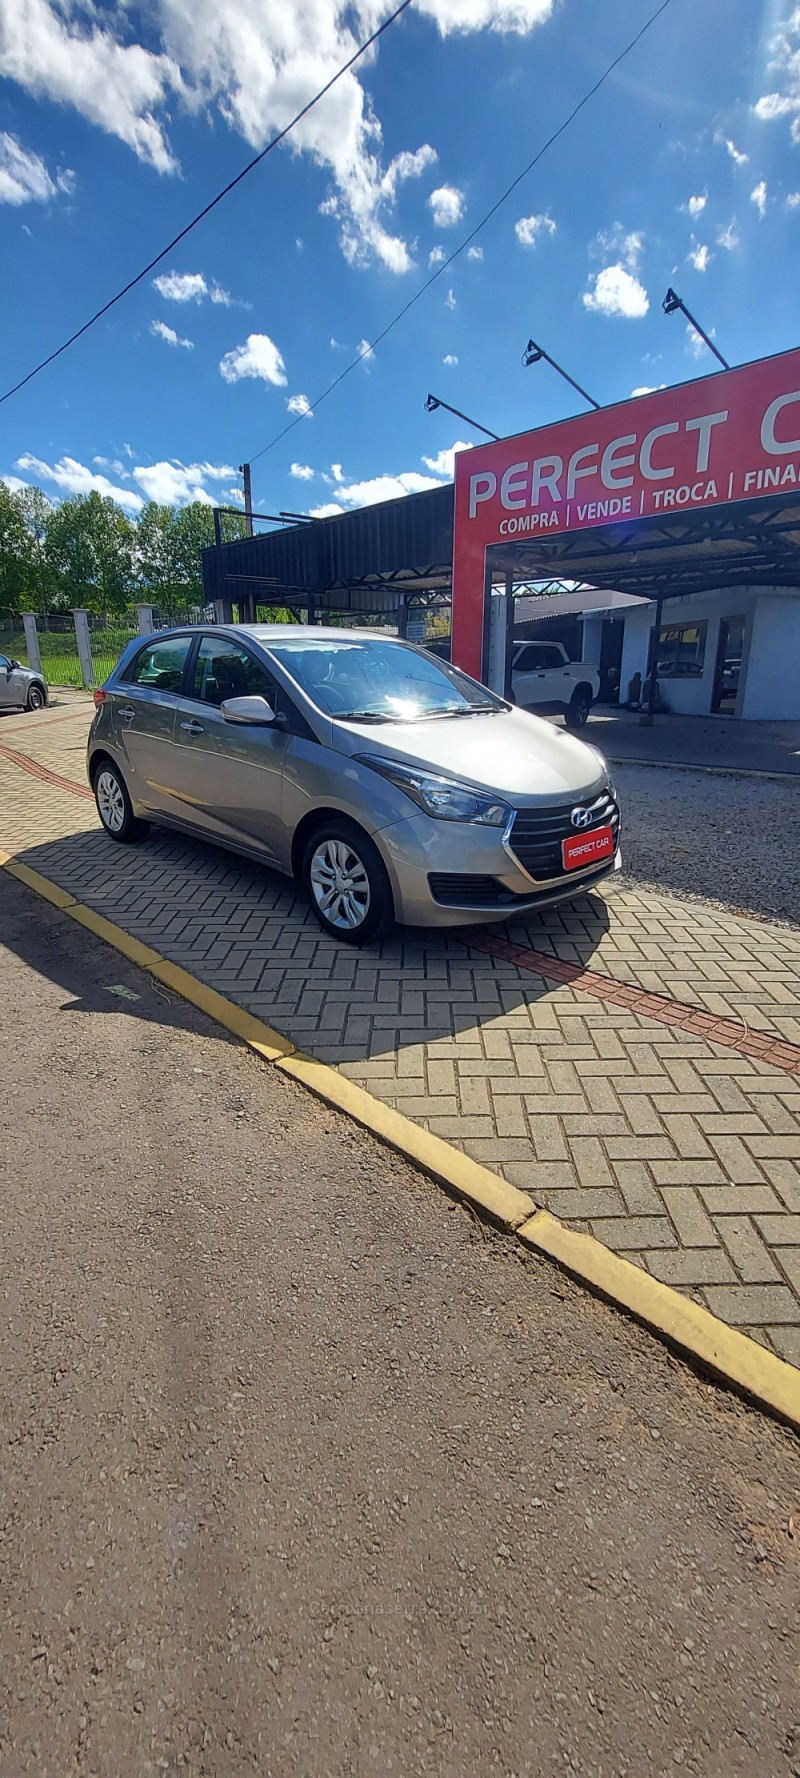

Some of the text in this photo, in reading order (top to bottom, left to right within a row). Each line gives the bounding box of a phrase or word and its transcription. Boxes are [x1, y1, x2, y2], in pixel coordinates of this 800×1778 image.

[469, 410, 729, 519] PERFECT
[499, 510, 559, 535] COMPRA
[577, 496, 632, 521] VENDE
[652, 480, 718, 508] TROCA
[743, 463, 800, 492] FINA
[568, 837, 609, 859] PERFECT CAR
